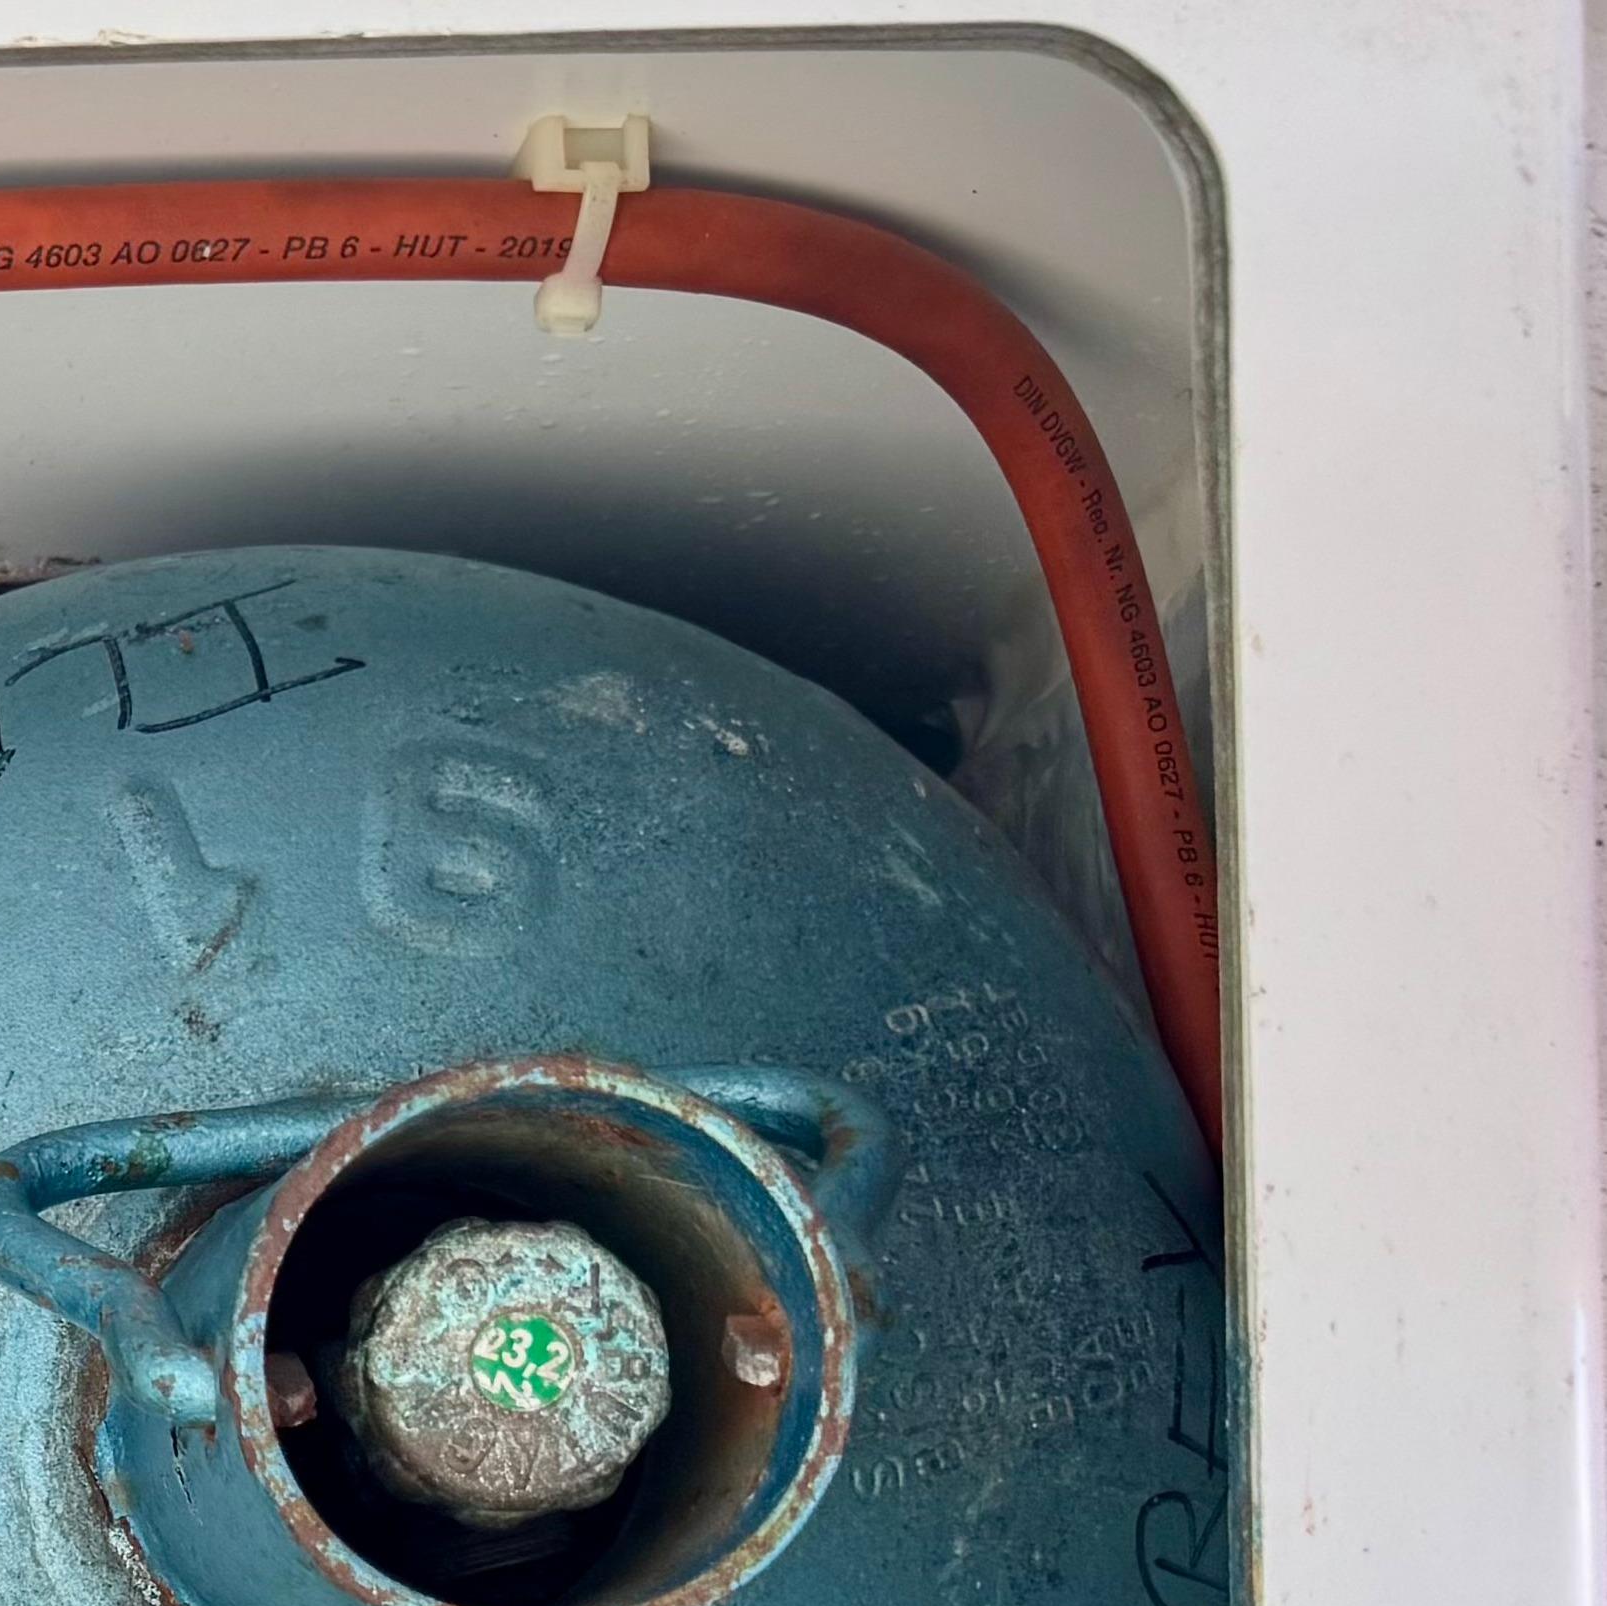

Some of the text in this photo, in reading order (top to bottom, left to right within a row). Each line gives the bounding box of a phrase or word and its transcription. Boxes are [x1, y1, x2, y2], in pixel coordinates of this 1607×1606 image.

[25, 243, 102, 269] 4603
[109, 239, 163, 265] AO
[170, 237, 251, 264] 0627
[282, 236, 330, 261] PB
[339, 234, 362, 260] 6
[393, 234, 469, 260] HUT
[499, 236, 575, 261] 2019
[1013, 374, 1047, 416] DIN
[1038, 412, 1087, 476] DVGW
[1115, 583, 1141, 624] NG
[1129, 629, 1158, 688] 4603
[1143, 696, 1168, 733] AO
[1153, 740, 1185, 801] 0627
[1173, 829, 1198, 863] PB
